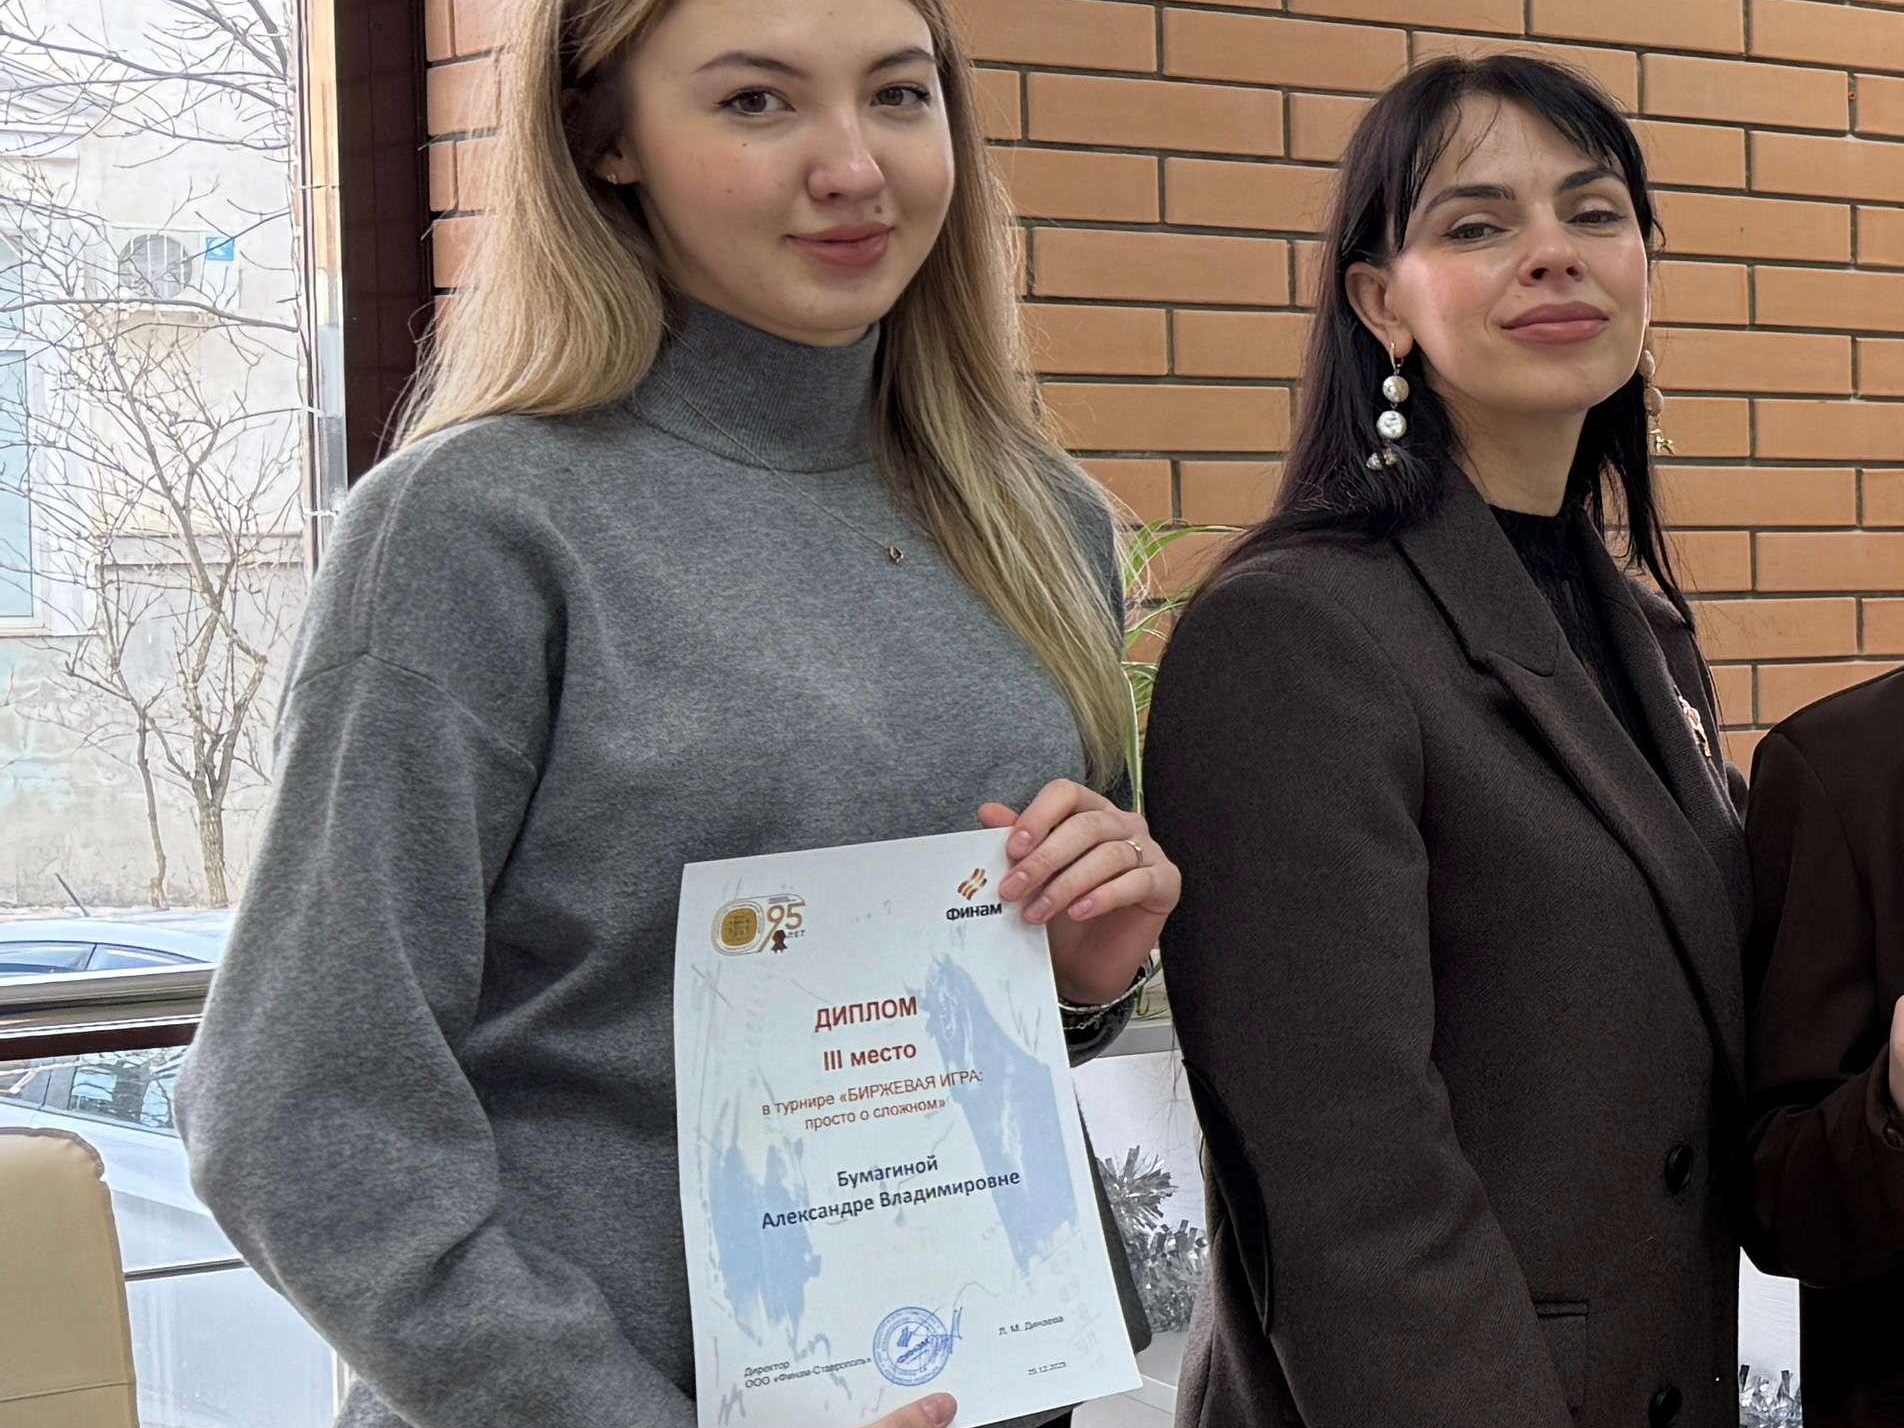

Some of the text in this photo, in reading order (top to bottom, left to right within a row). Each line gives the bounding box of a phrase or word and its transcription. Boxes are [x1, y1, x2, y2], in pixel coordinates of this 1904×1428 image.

[814, 996, 918, 1033] ДИПЛОМ
[824, 1043, 917, 1071] III место
[762, 1070, 984, 1117] в турнире «БИРЖЕВАЯ ИГРА:
[805, 1098, 946, 1132] просто о сложном»
[837, 1154, 938, 1189] Бумагиной
[762, 1171, 1021, 1229] Александре Владимировне
[744, 1376, 770, 1389] ООО
